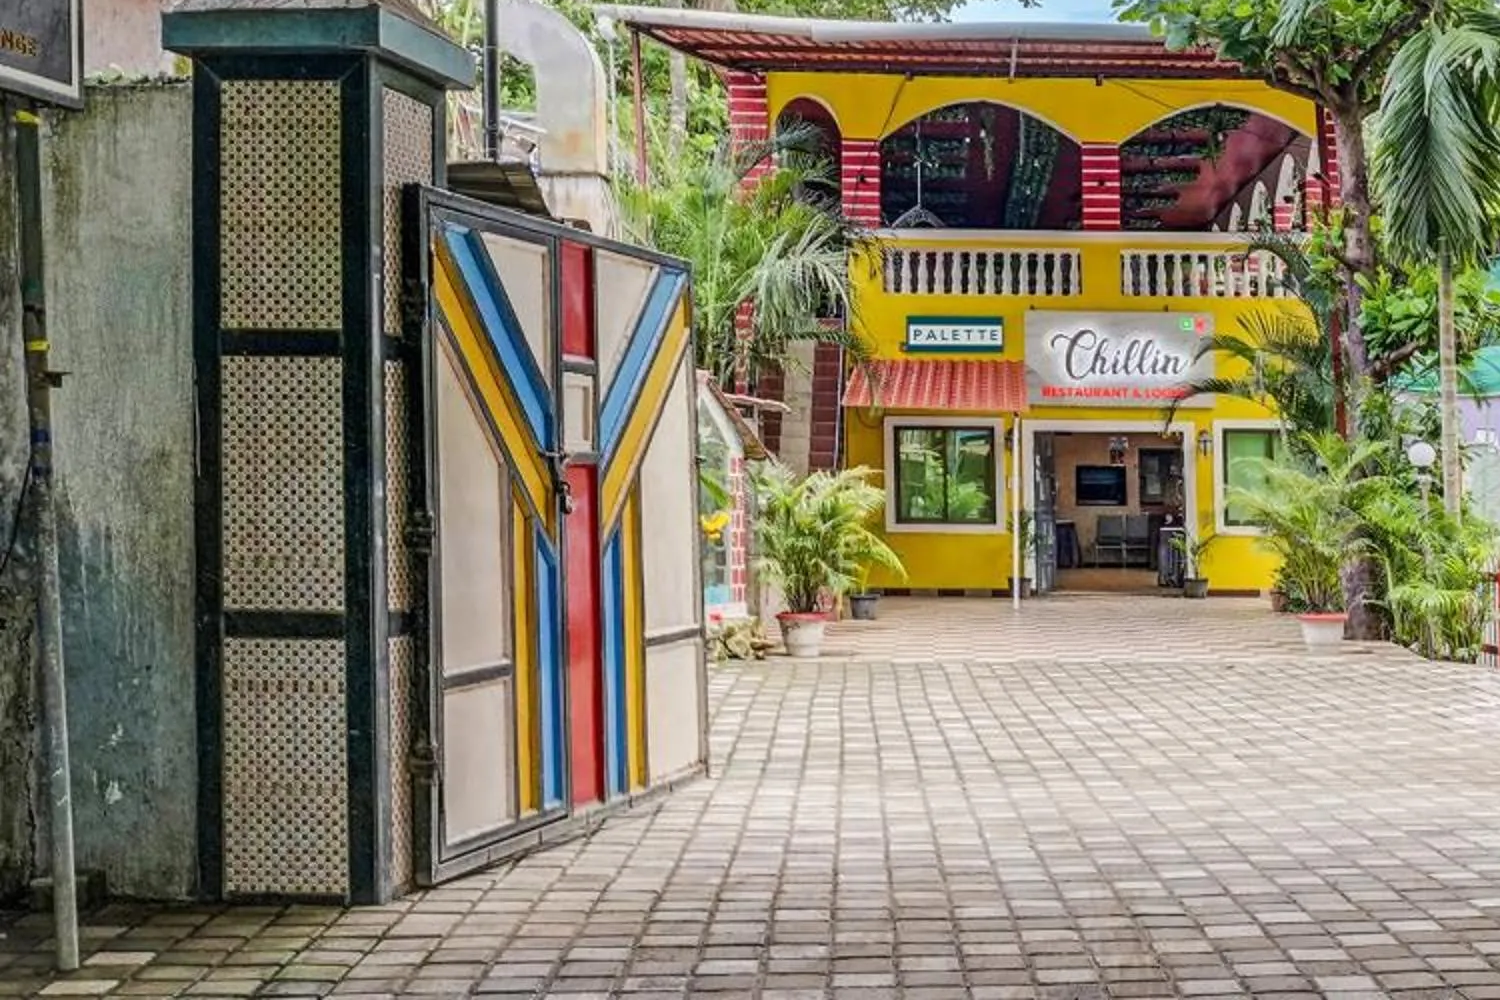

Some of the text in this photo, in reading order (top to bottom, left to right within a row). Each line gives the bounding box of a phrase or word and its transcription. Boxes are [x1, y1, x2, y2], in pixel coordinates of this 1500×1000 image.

[913, 329, 999, 341] PALETTE
[1050, 328, 1188, 381] Chillin
[1041, 385, 1129, 399] RESTAURANT
